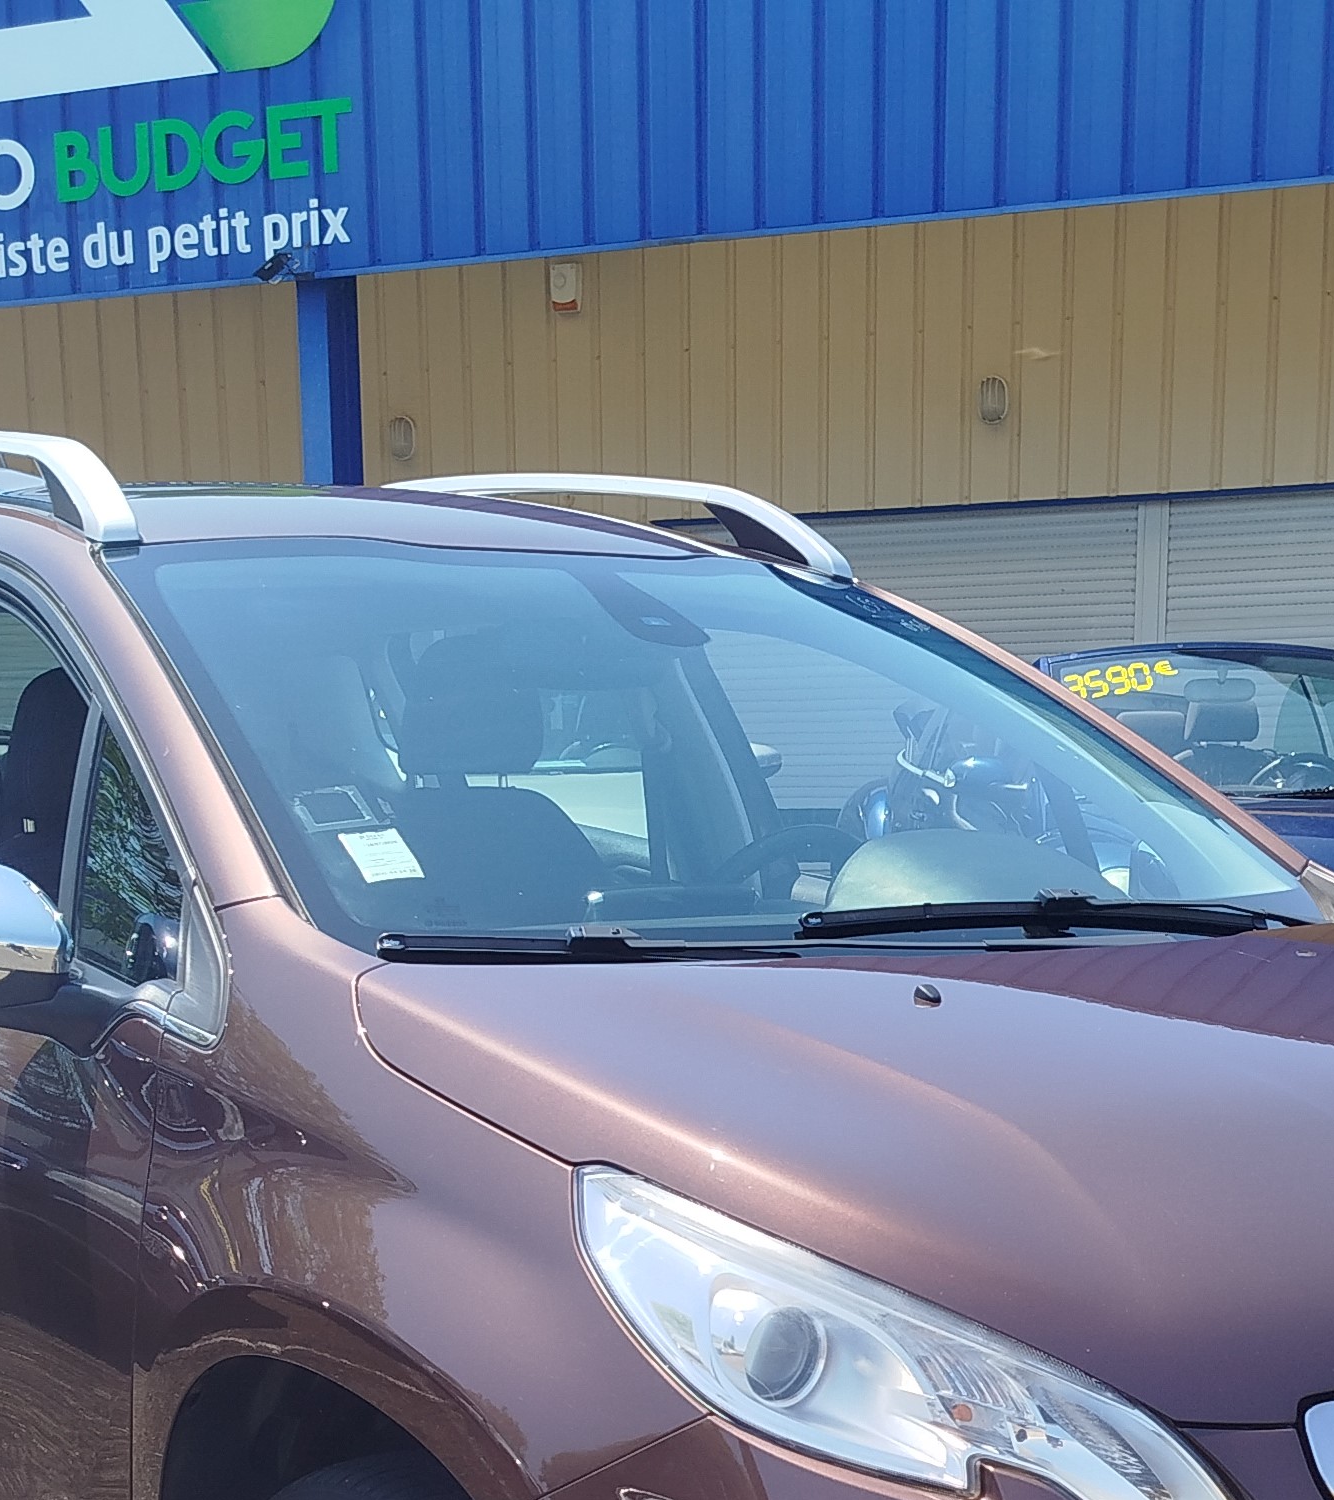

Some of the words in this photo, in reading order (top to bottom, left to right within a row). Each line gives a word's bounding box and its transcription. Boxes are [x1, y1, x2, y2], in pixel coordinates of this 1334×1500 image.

[54, 97, 353, 203] BUDGET
[83, 221, 135, 268] du
[147, 209, 252, 274] petit
[263, 198, 352, 256] prix
